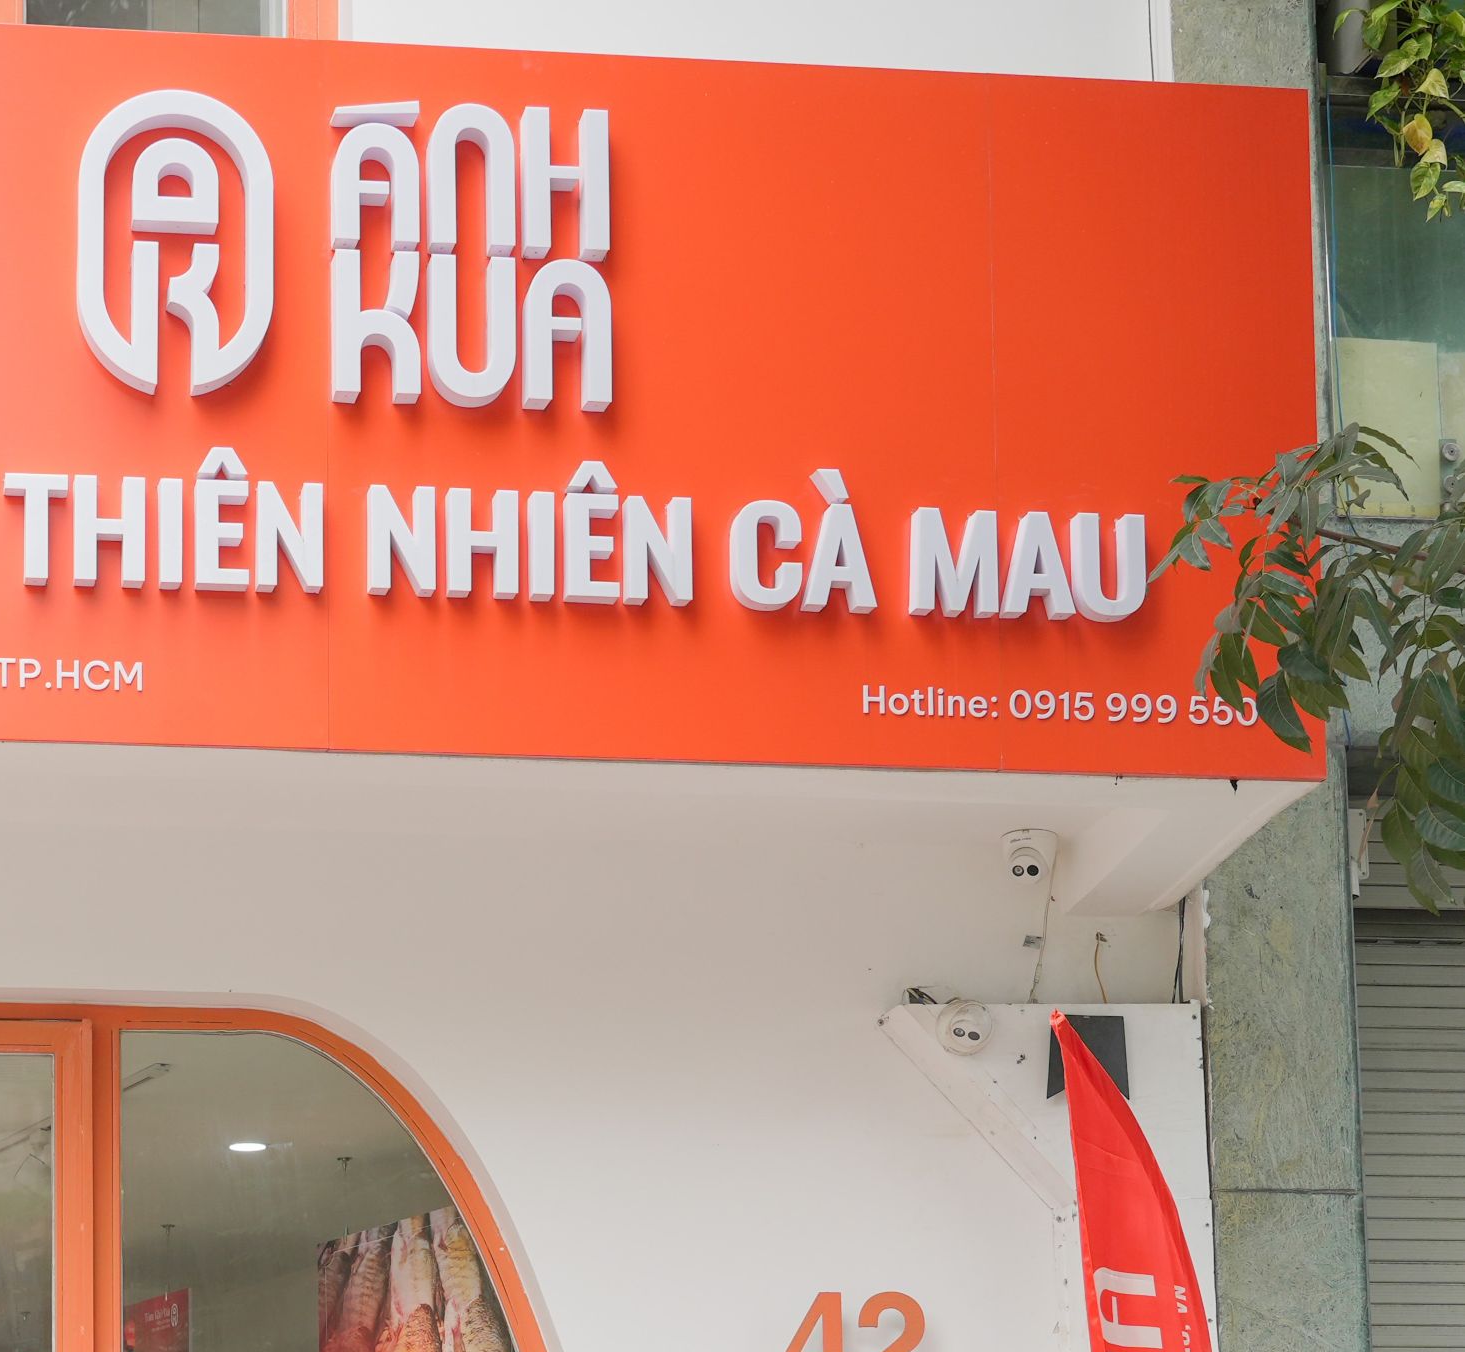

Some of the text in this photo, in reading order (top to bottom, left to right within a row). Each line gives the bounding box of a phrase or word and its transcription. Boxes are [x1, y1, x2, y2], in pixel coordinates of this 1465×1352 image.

[330, 249, 612, 412] KUA
[3, 447, 323, 594] THIÊN
[367, 461, 692, 606] NHIÊN
[730, 469, 877, 614] CÀ
[908, 507, 1146, 622] MAU
[862, 684, 1258, 727] Hotline: 0915 999 550
